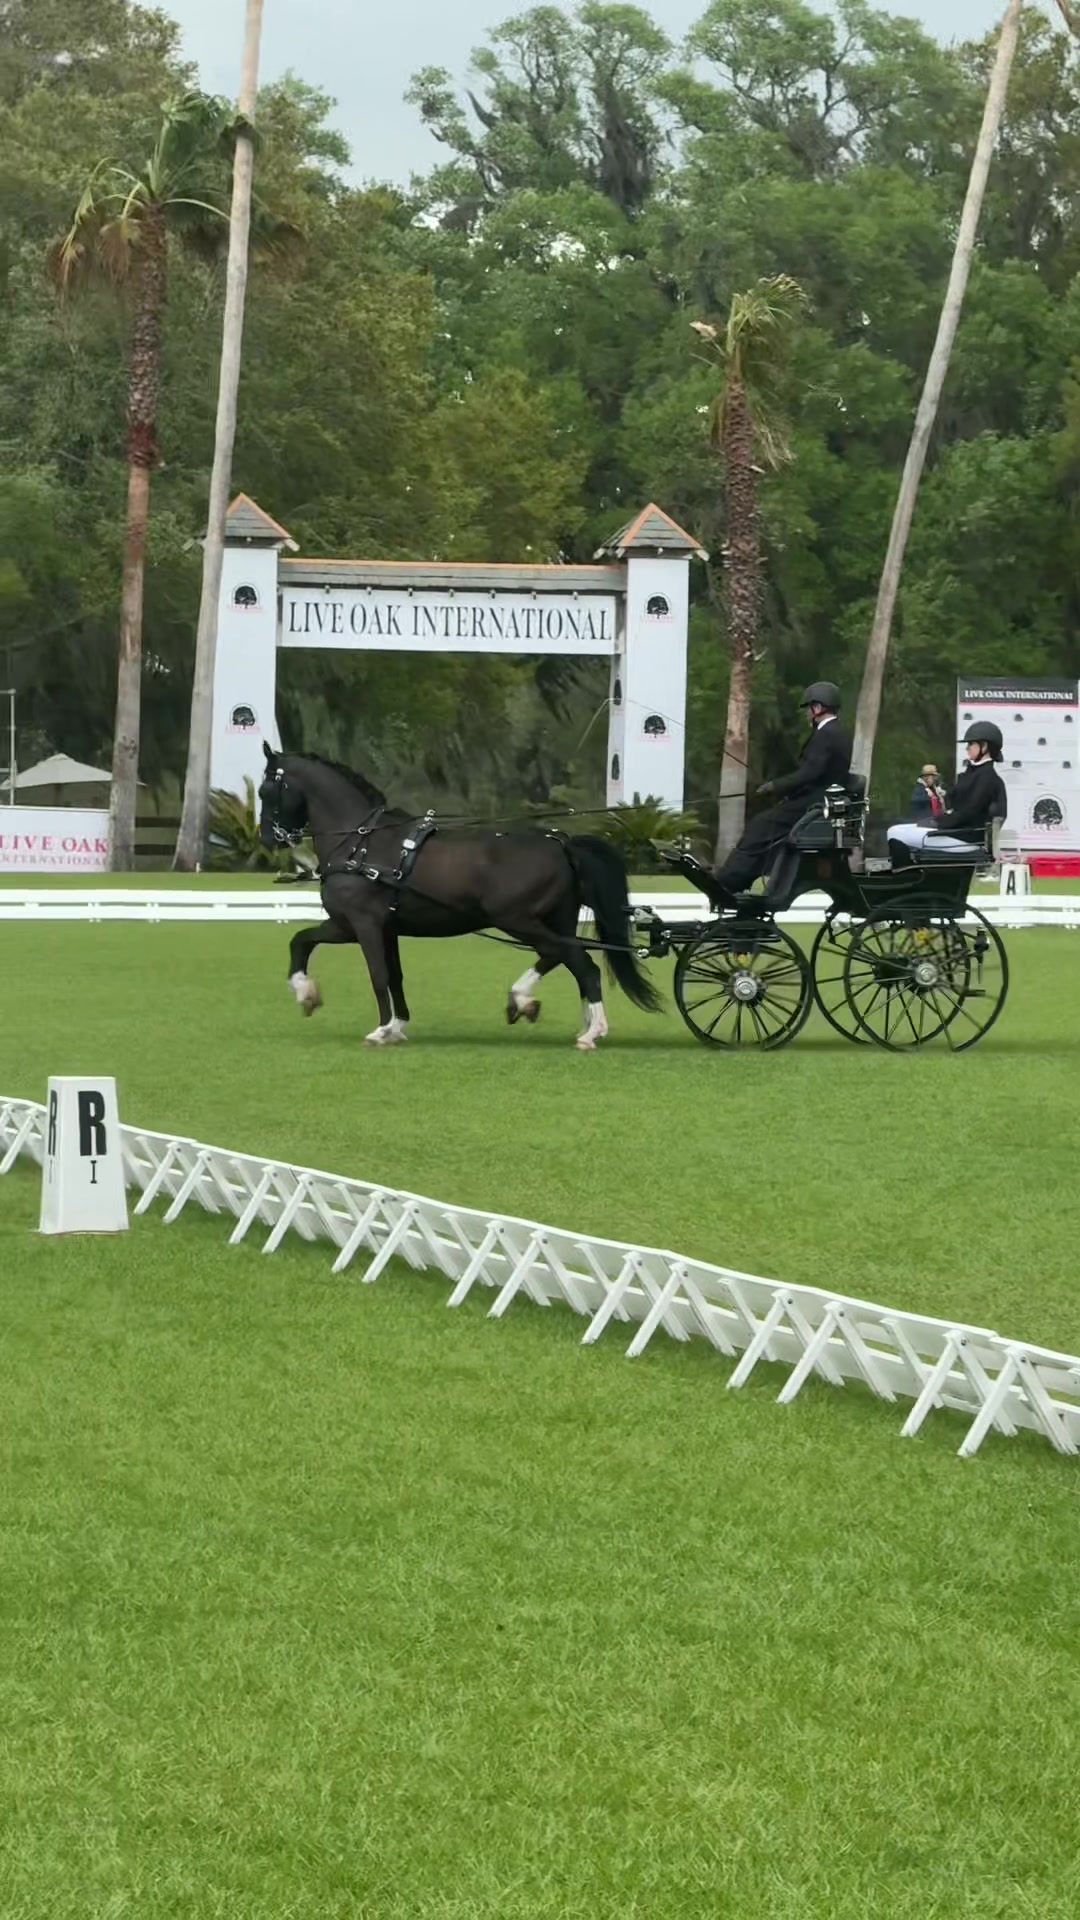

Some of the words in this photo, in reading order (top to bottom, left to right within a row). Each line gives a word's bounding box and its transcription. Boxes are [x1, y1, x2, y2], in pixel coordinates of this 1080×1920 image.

[289, 601, 344, 634] LIVE
[350, 603, 403, 636] OAK
[412, 605, 613, 641] INTERNATIONAL
[965, 689, 984, 699] LIVE
[985, 690, 1005, 699] OAK
[1005, 690, 1074, 700] INTERNATIONAL
[0, 834, 53, 851] LIVE
[61, 837, 109, 853] OAK
[1, 854, 109, 866] NTERNATIONAL
[1005, 869, 1016, 896] A
[48, 1089, 58, 1156] R
[78, 1090, 107, 1156] R
[90, 1160, 97, 1184] I
